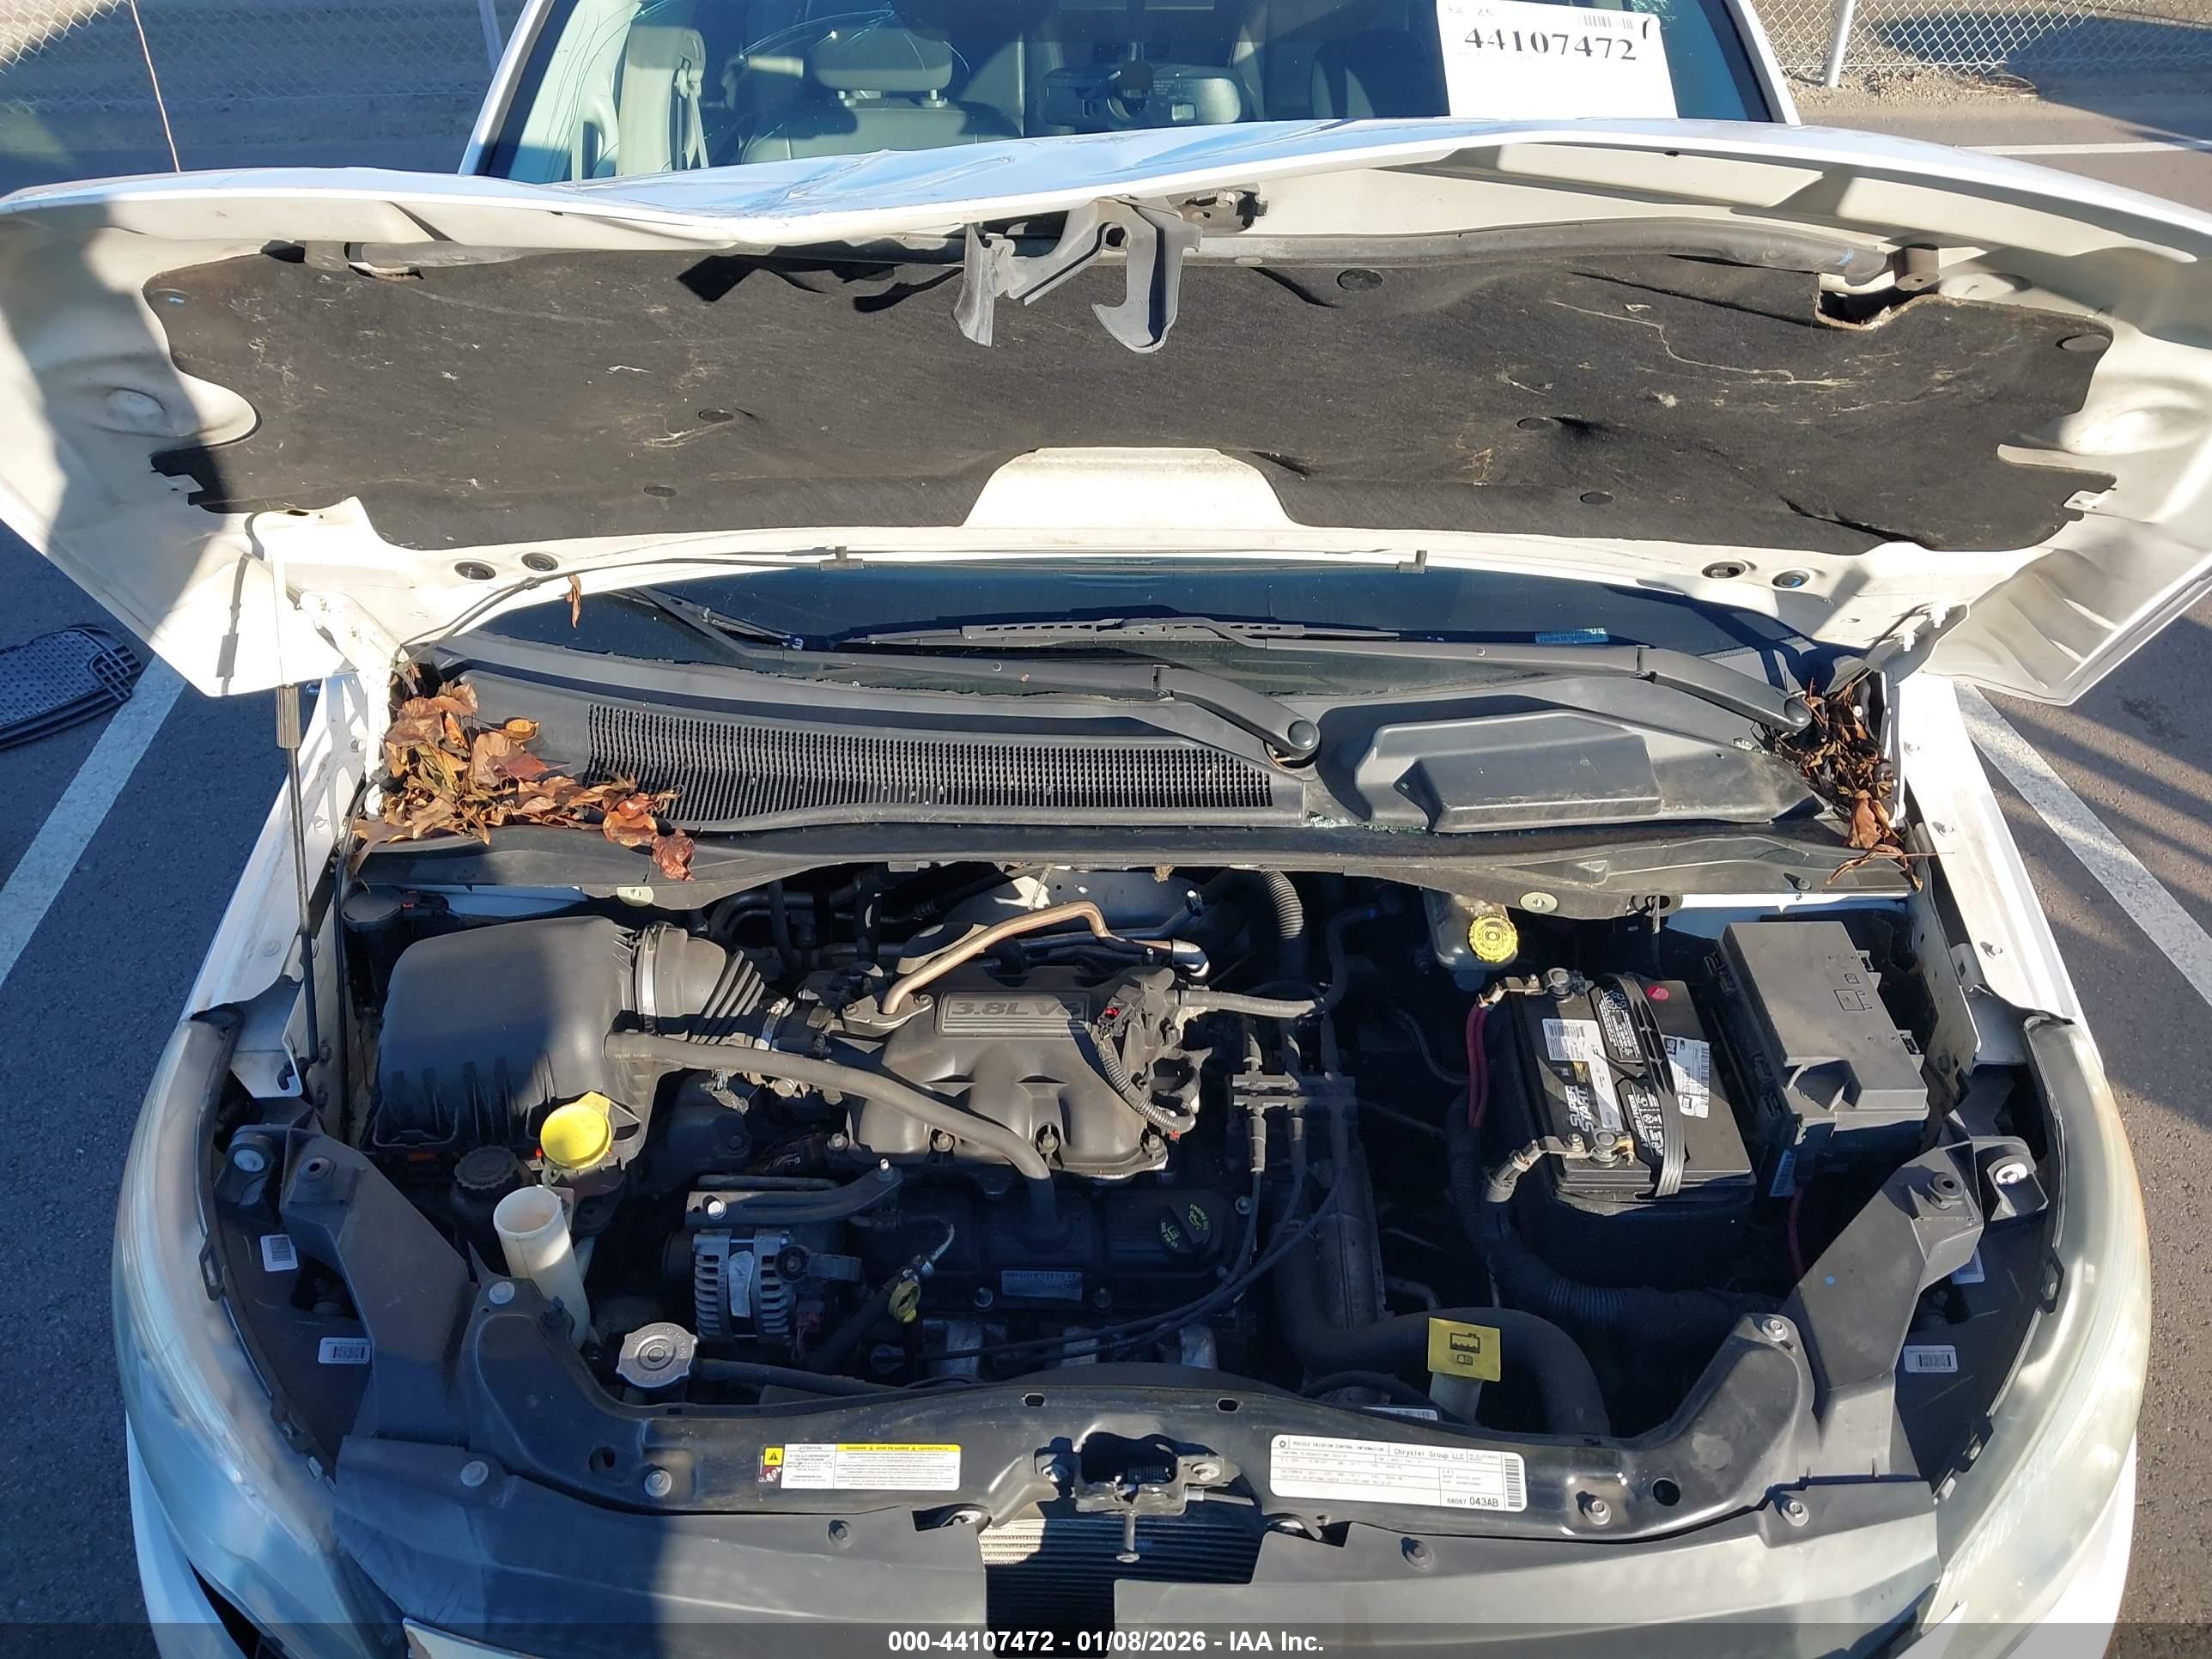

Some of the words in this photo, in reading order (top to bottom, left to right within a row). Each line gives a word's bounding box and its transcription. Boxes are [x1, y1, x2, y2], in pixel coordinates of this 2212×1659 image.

[1464, 27, 1637, 61] 44107472
[951, 1002, 1030, 1015] 3.8L
[1565, 1085, 1583, 1127] SUPER
[1574, 1085, 1595, 1133] START
[1394, 1448, 1425, 1458] Chrysler
[1429, 1450, 1449, 1459] Group
[1452, 1452, 1464, 1461] LLC
[1469, 1497, 1499, 1508] 043AB
